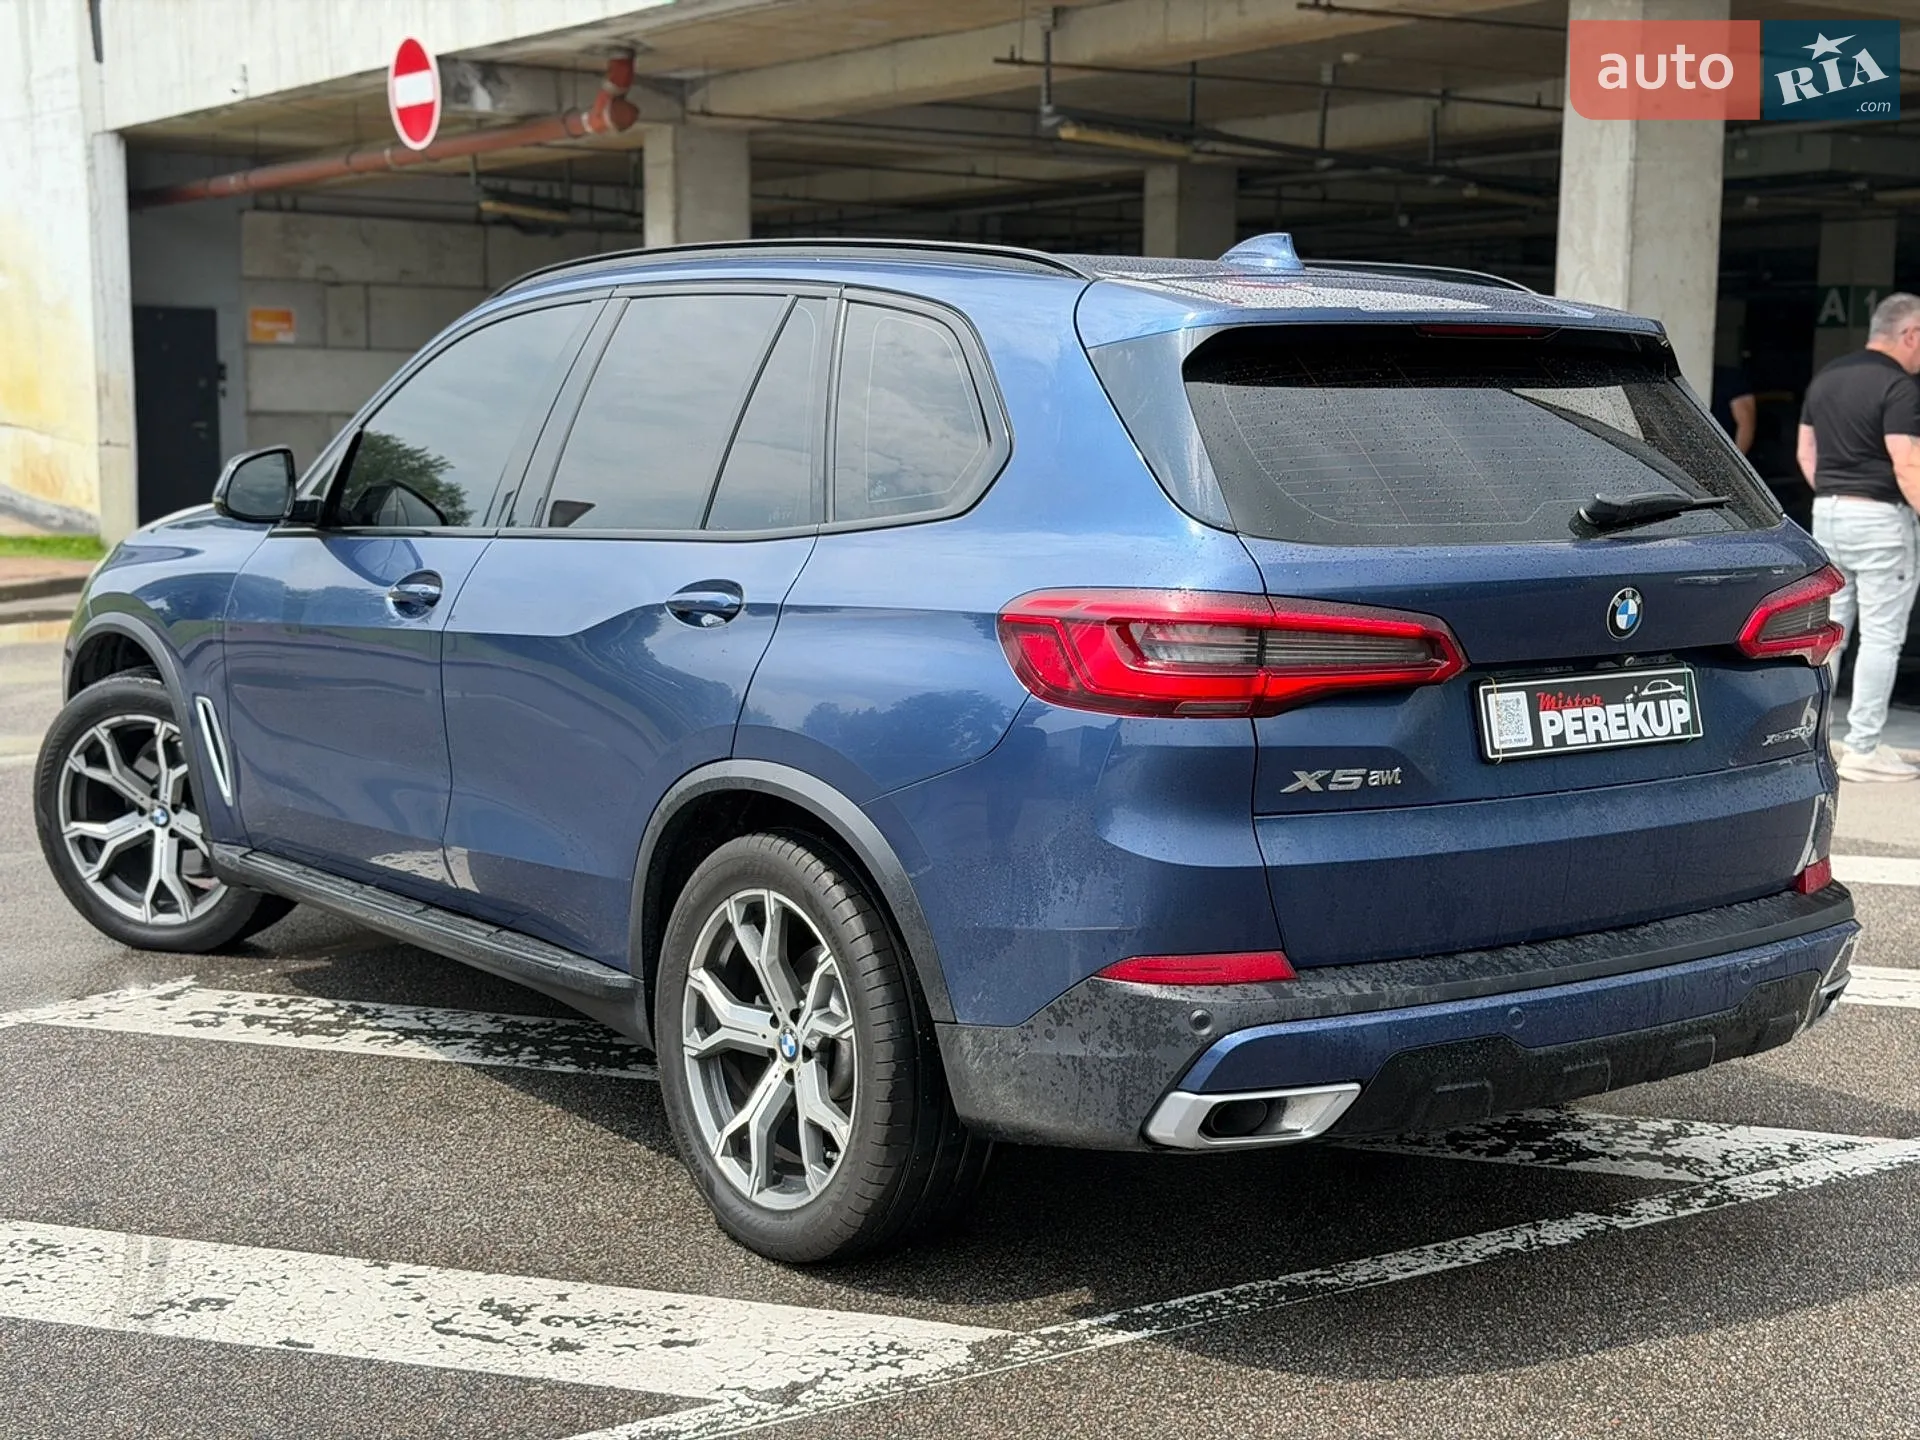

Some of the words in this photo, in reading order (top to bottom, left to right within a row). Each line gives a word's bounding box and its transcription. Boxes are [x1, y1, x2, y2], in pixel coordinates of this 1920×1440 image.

[1816, 287, 1846, 325] A
[1536, 691, 1604, 711] Mister
[1539, 698, 1690, 747] PEREKUP
[1280, 768, 1367, 793] X5
